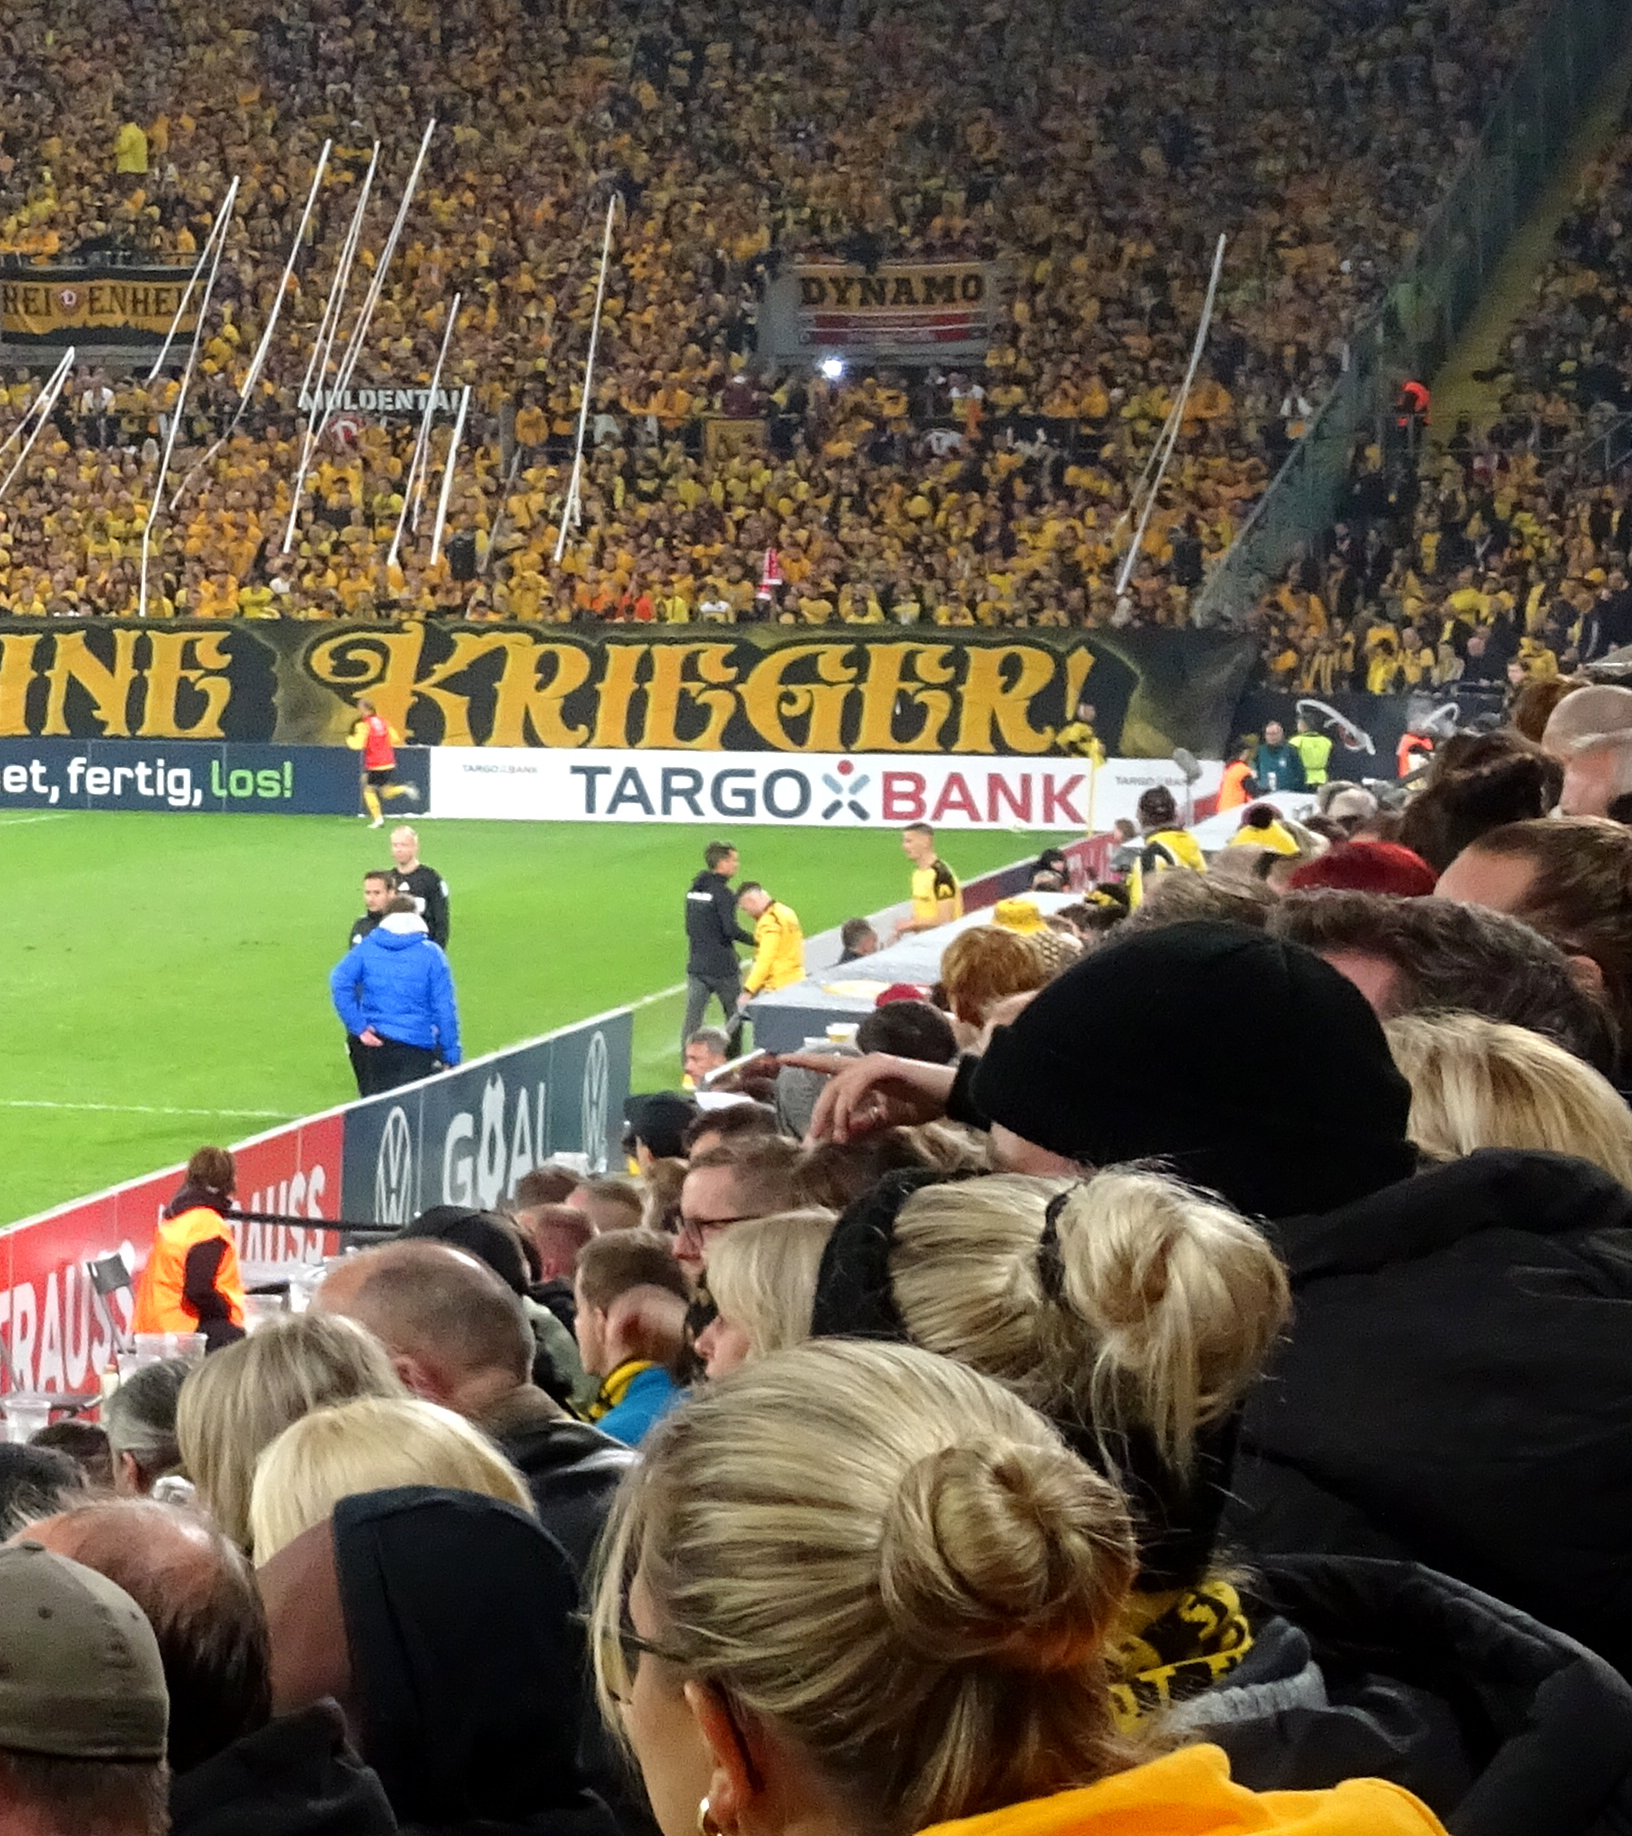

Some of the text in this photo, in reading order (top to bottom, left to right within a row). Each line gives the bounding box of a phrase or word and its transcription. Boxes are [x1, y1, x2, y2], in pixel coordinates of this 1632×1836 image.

[800, 273, 985, 306] DYNAMO
[309, 622, 1095, 755] KRIEGER!
[68, 757, 203, 807] fertig,
[211, 760, 294, 799] los!
